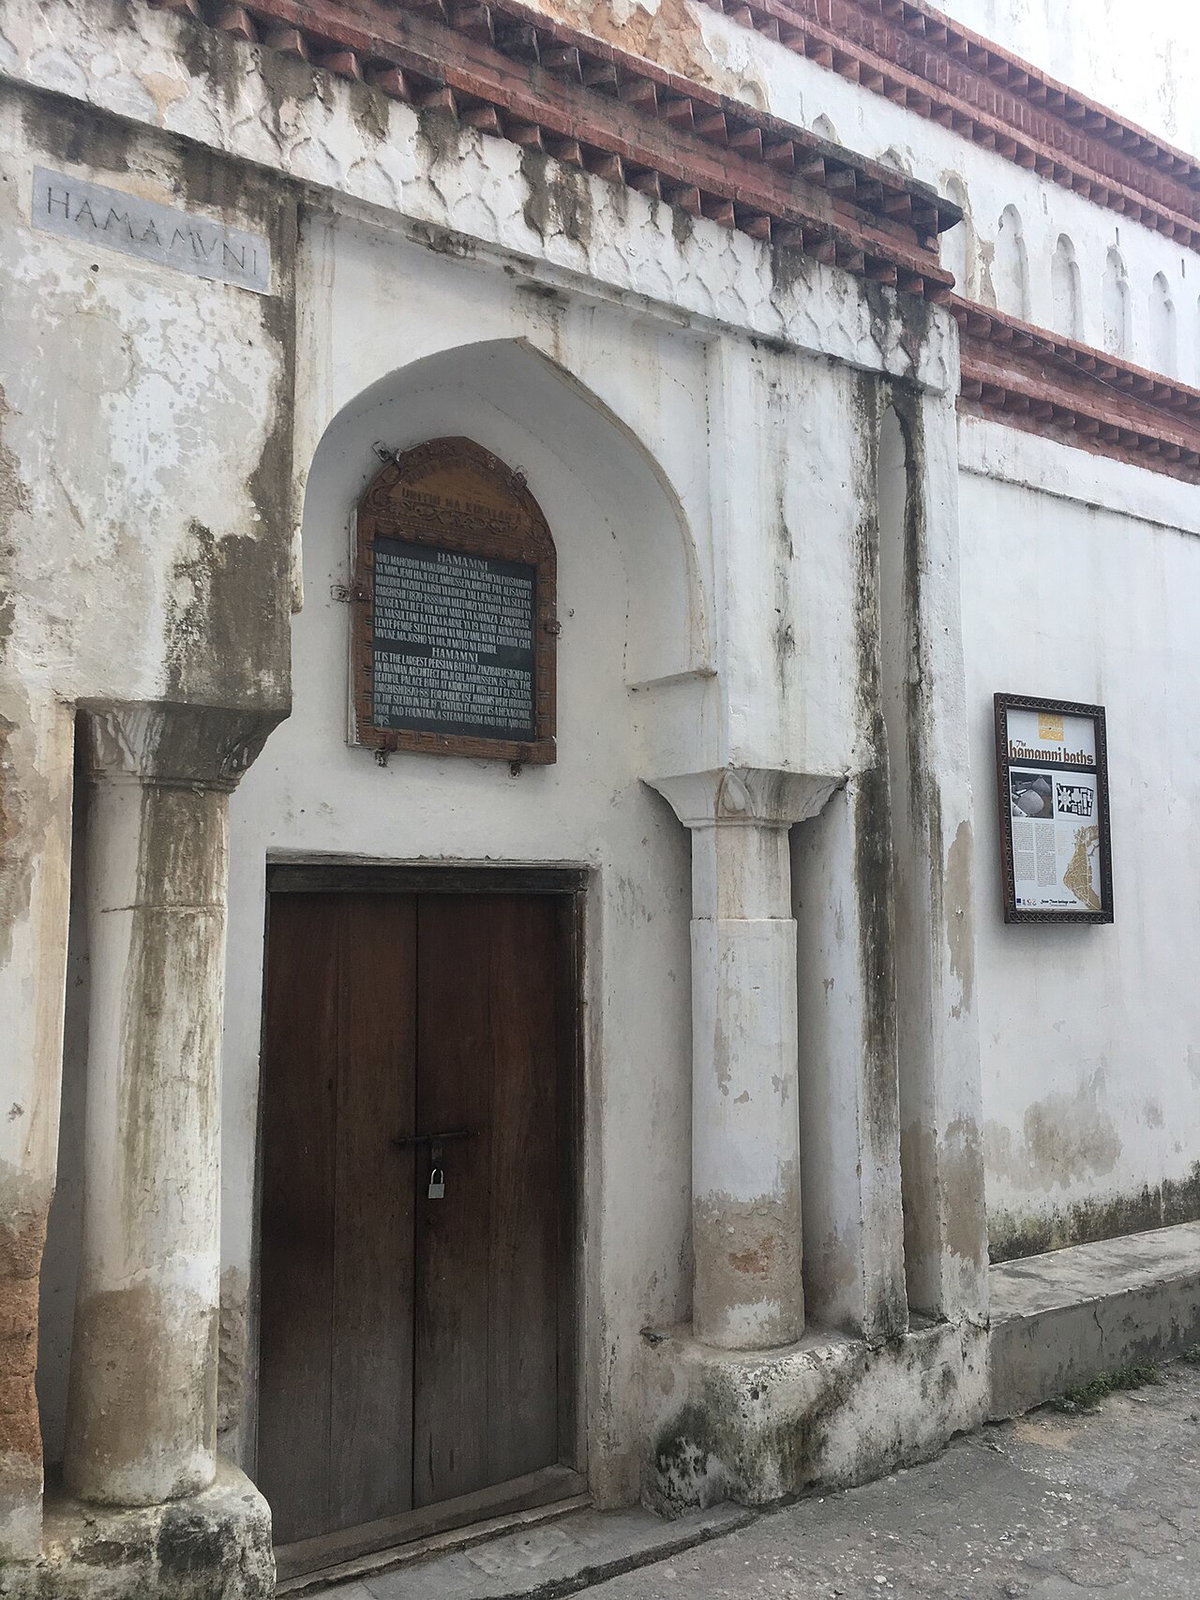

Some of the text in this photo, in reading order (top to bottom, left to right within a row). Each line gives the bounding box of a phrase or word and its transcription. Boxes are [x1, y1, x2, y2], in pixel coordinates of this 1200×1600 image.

[437, 552, 488, 571] HAMAMNI
[420, 613, 442, 625] KATIKA
[413, 623, 427, 634] SITA
[452, 639, 469, 650] MOTO
[389, 653, 401, 664] THE
[402, 654, 427, 667] LARGEST
[428, 658, 453, 670] PERSIAN
[454, 661, 470, 672] BATH
[432, 647, 478, 663] HAMAMNI
[383, 663, 408, 675] IRANIAN
[408, 666, 440, 679] ARCHITECT
[507, 678, 519, 688] WAS
[520, 680, 532, 690] THE
[401, 675, 423, 687] PALACE
[488, 686, 502, 696] BUILT
[510, 688, 531, 699] SULTAN
[431, 689, 442, 699] FOR
[420, 698, 431, 708] THE
[374, 704, 389, 716] POOL
[391, 706, 404, 717] AND
[442, 711, 463, 723] STEAM
[465, 713, 483, 725] ROOM
[484, 715, 495, 726] AND
[496, 716, 507, 727] HOT
[1008, 740, 1094, 764] hamamni baths
